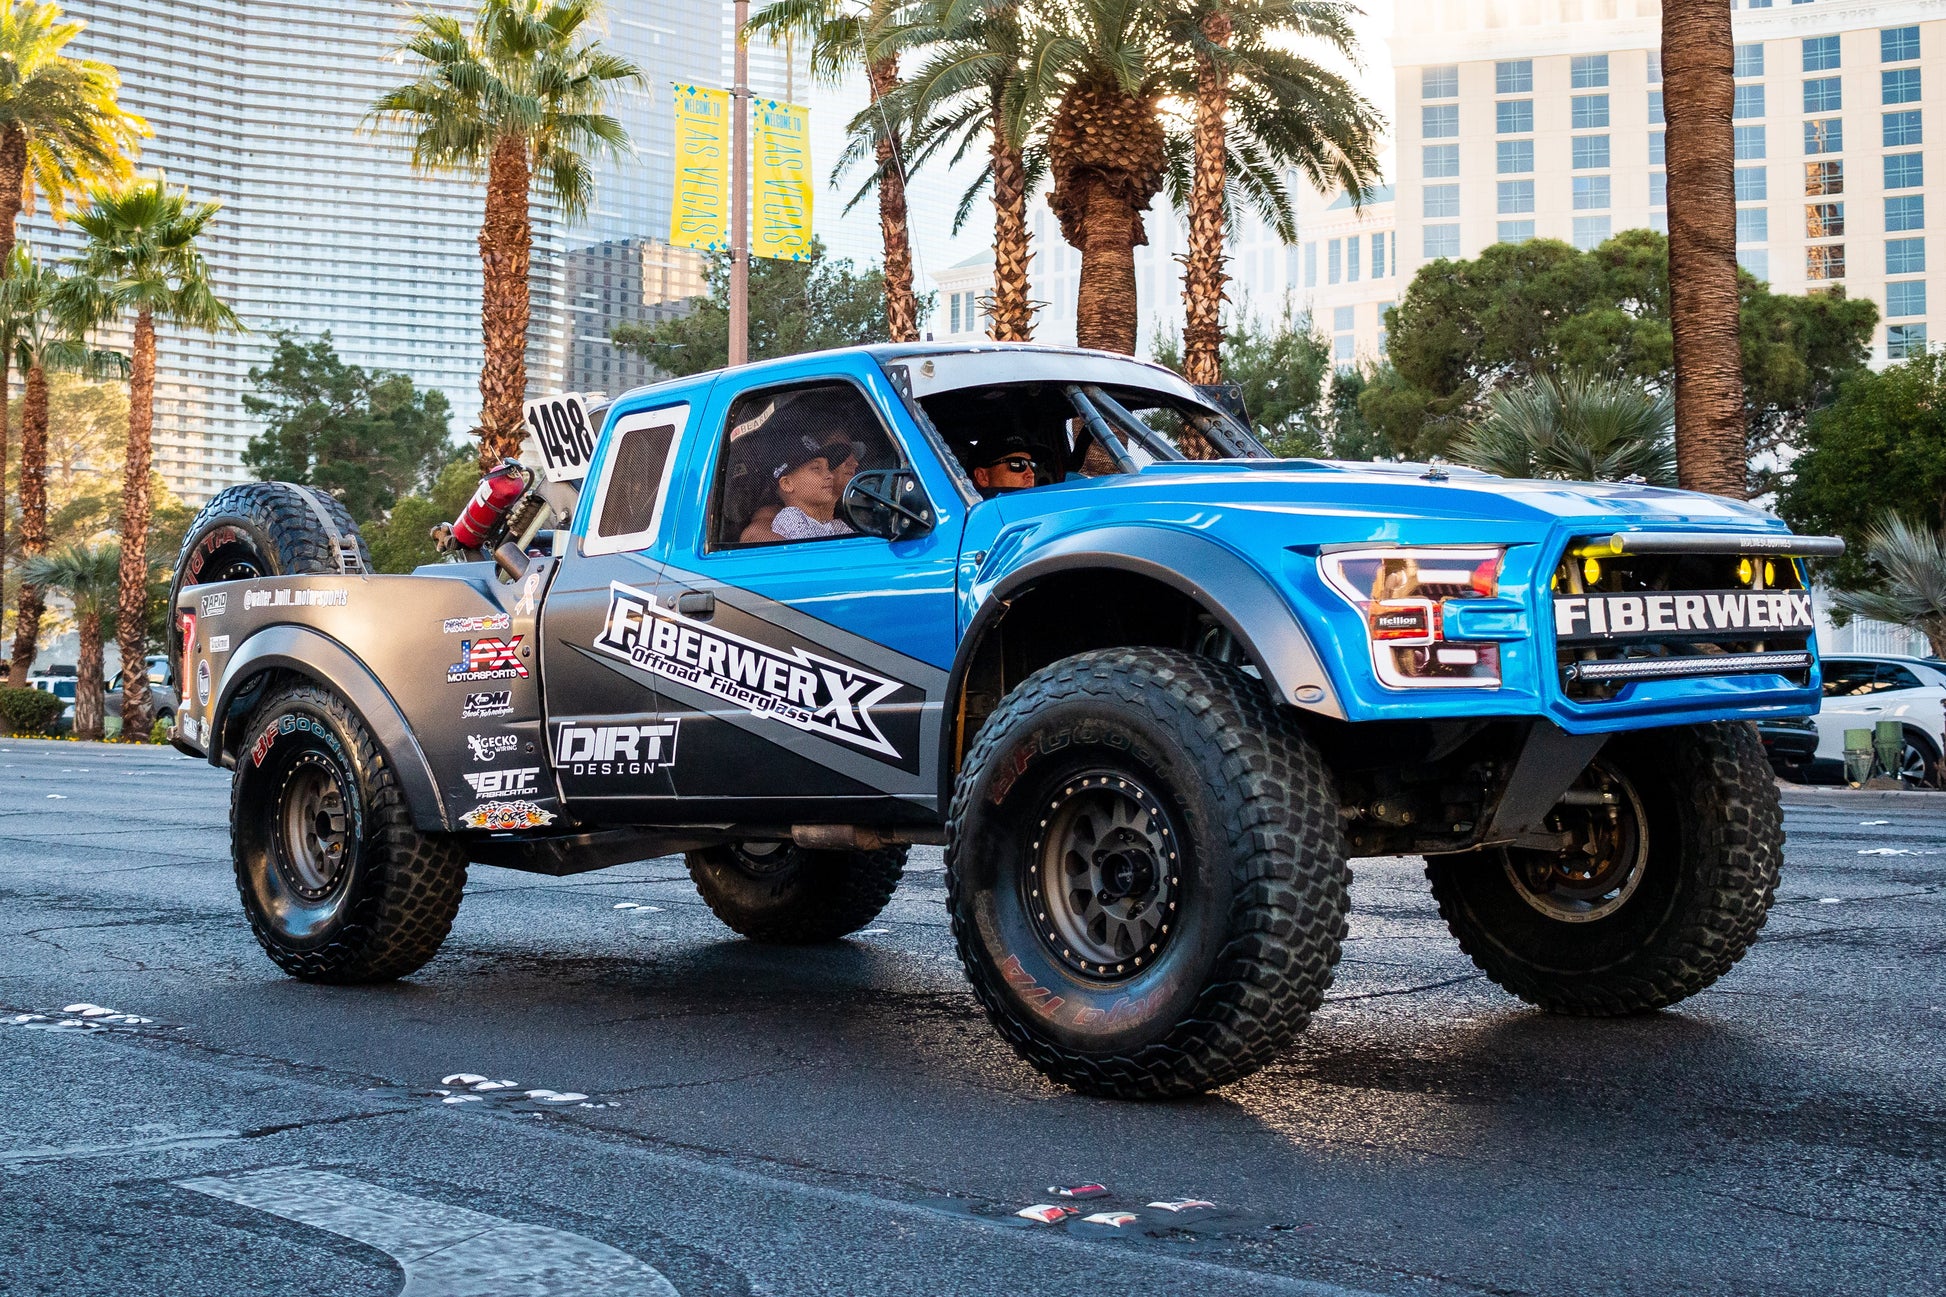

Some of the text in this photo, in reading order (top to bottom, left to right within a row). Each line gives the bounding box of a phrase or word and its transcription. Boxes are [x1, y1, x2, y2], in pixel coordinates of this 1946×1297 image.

[684, 98, 721, 118] WELCOME TO
[764, 111, 801, 132] WELCOME TO
[680, 117, 720, 236] LAS VEGAS
[763, 131, 804, 247] LAS VEGAS
[528, 398, 594, 469] 1498
[740, 410, 769, 434] BEARD
[1379, 616, 1417, 626] Hellion
[1553, 593, 1814, 636] FIBERWERX
[447, 634, 530, 679] JAX
[608, 597, 871, 730] FIBERWERX
[447, 668, 517, 683] MOTORSPORTS
[631, 647, 812, 724] Offroad Fiberglass
[464, 690, 512, 710] KDM
[480, 734, 518, 748] GECKO
[494, 744, 518, 753] WIRING
[560, 725, 674, 761] DIRT
[476, 767, 540, 793] BTF
[573, 762, 655, 776] DESIGN
[475, 787, 538, 800] FABRICATION
